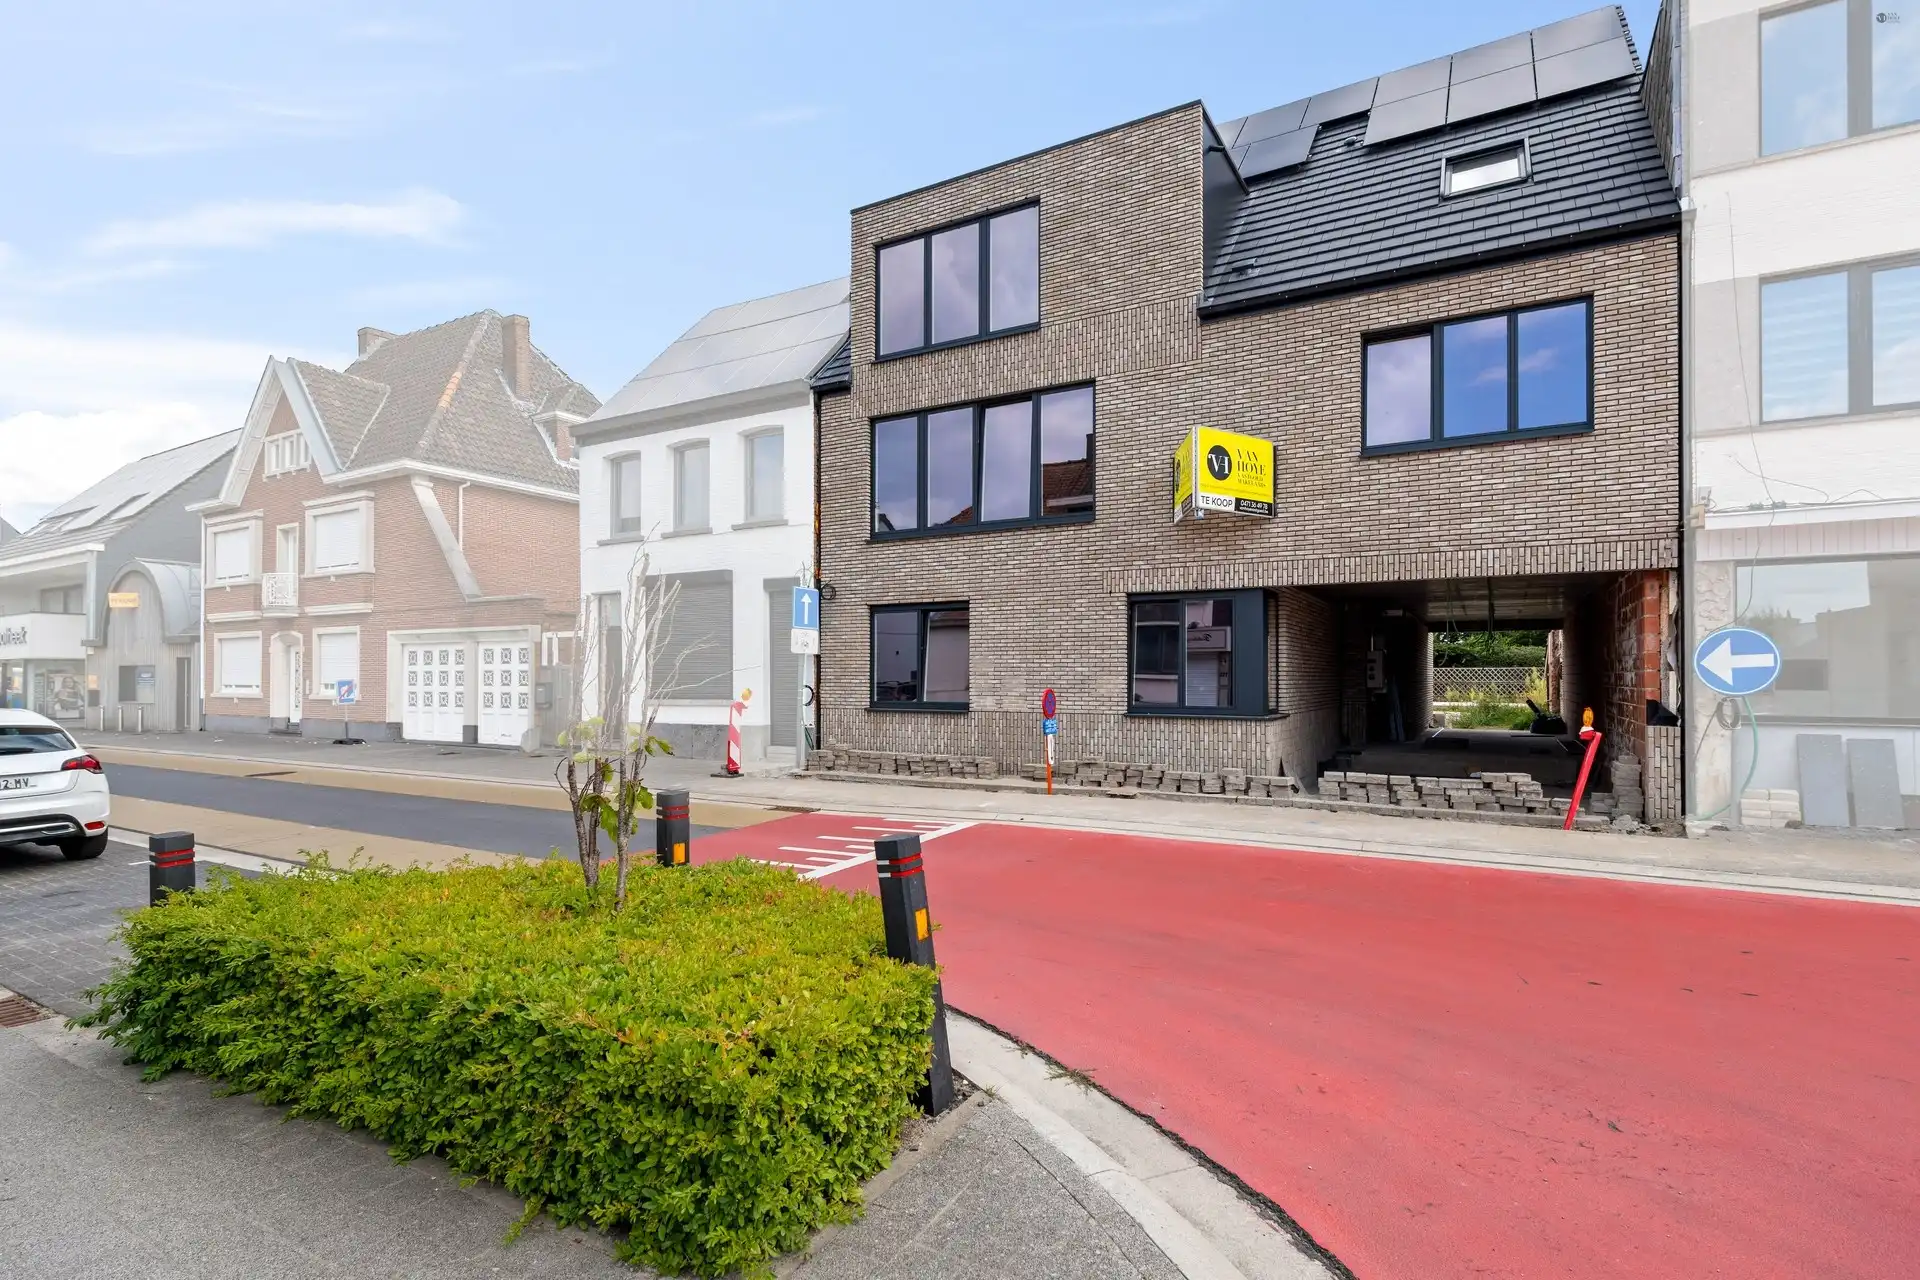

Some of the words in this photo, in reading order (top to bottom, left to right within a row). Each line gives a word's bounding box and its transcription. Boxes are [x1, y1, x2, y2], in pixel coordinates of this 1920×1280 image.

[1236, 448, 1259, 463] VAN
[1237, 460, 1266, 476] HOYE
[1201, 495, 1210, 505] TE
[1211, 497, 1233, 508] KOOP
